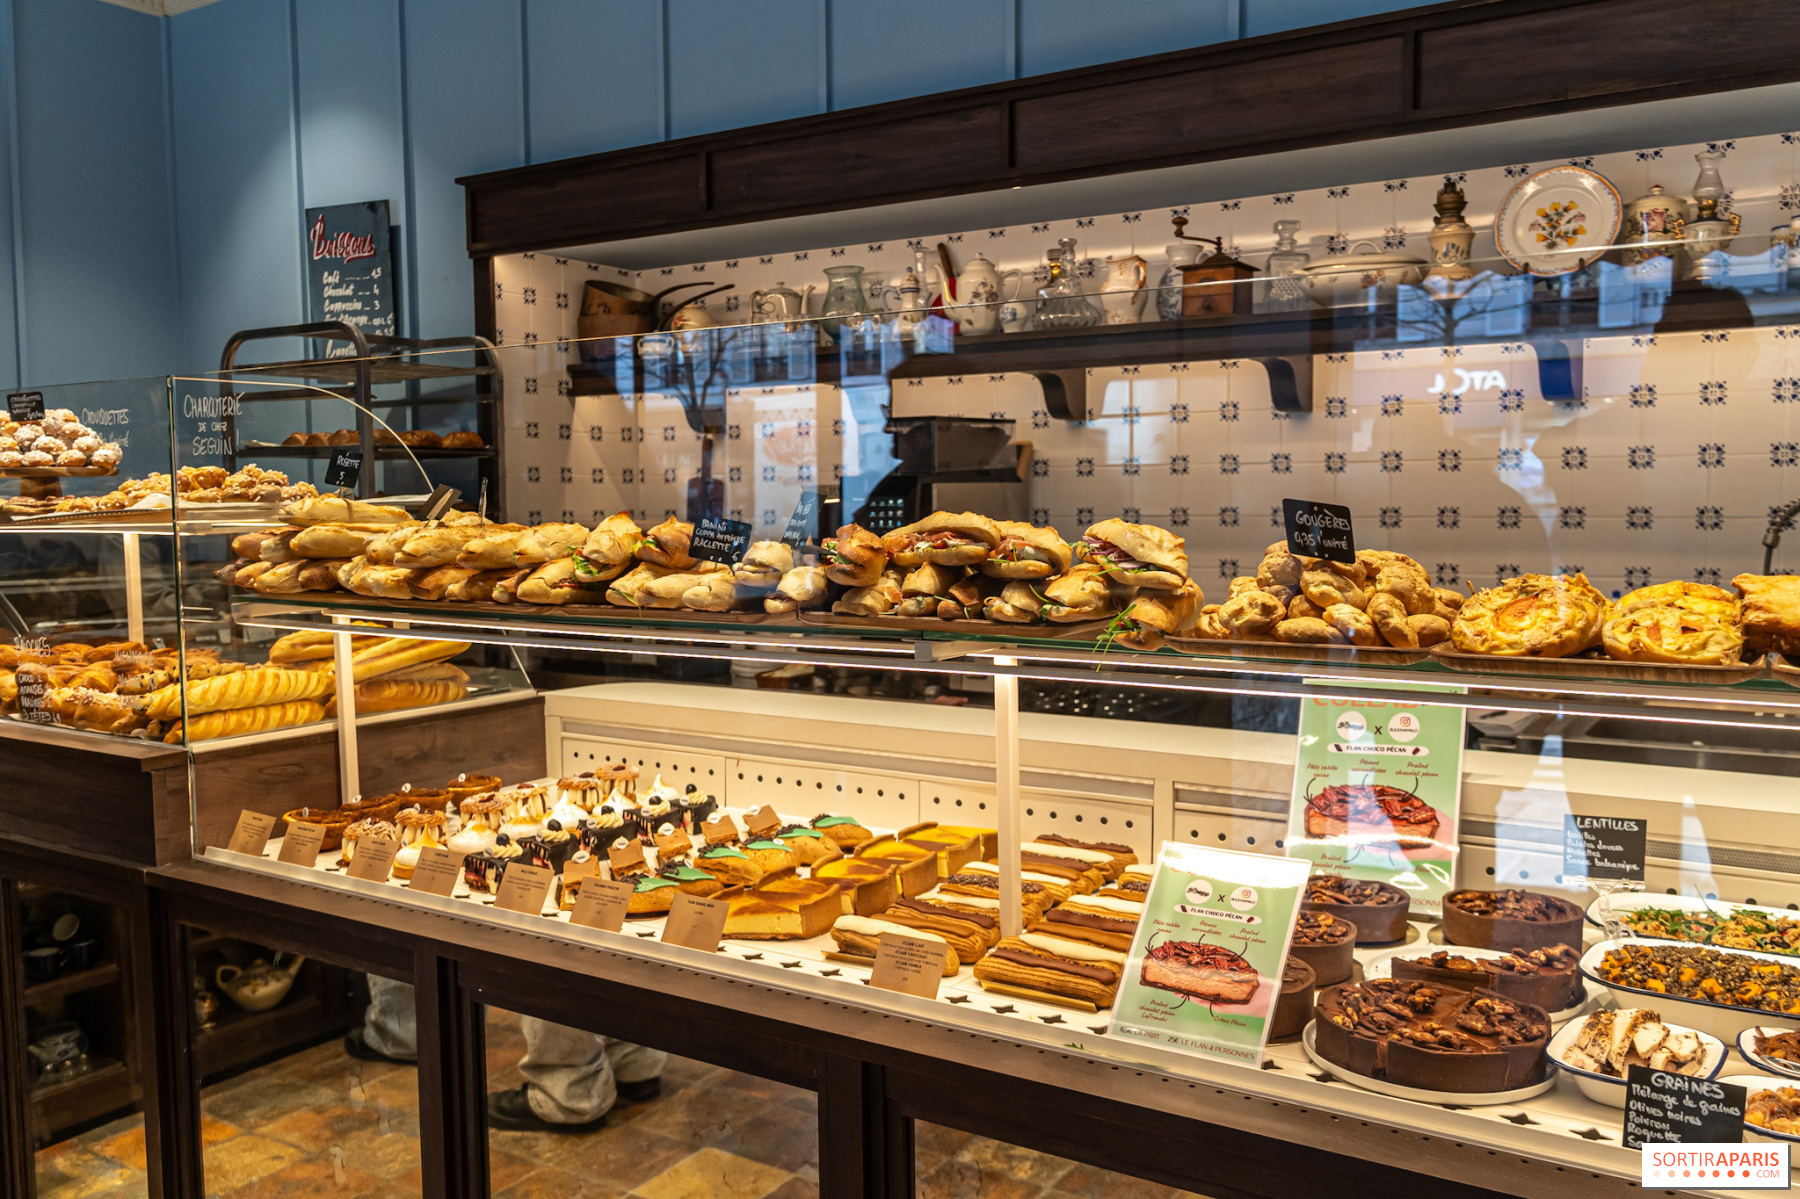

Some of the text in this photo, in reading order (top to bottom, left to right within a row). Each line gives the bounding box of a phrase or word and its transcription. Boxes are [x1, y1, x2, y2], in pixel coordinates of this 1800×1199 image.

[323, 270, 340, 286] Café
[324, 284, 380, 298] Chocolat 4
[324, 299, 380, 313] Cappuccino 3
[198, 422, 228, 433] DE CHEZ
[192, 436, 233, 457] SEGUIN
[336, 455, 361, 469] ROSETTE
[339, 471, 346, 480] 5
[702, 518, 728, 531] PANINI
[1295, 509, 1350, 530] GOUGÈRES
[695, 528, 715, 538] COPPA
[1294, 531, 1316, 547] 0,35
[693, 537, 732, 552] RACLETTE
[731, 551, 741, 561] 6
[1374, 725, 1383, 735] X
[1576, 817, 1639, 832] LENTILLES
[1321, 853, 1342, 861] Praliné
[1217, 894, 1226, 903] X
[1190, 907, 1204, 915] FLAN
[1225, 912, 1243, 920] PÉCAN
[1240, 927, 1259, 936] Praliné
[1228, 933, 1267, 944] chocolat pécan
[1150, 999, 1169, 1008] Praliné
[1139, 1005, 1176, 1016] chocolat pécan
[1213, 1015, 1247, 1027] Crème Pécan
[1144, 1031, 1160, 1039] PART
[1167, 1036, 1180, 1044] 25€
[1180, 1038, 1189, 1046] LE
[1190, 1040, 1208, 1050] FLAN
[1213, 1045, 1255, 1060] PERSONNES
[1650, 1072, 1725, 1099] GRAINES
[1682, 1094, 1697, 1108] de
[1698, 1100, 1741, 1117] graines
[1629, 1099, 1702, 1126] Olives noires
[1628, 1110, 1670, 1131] Poivron
[1627, 1121, 1681, 1143] Roquette
